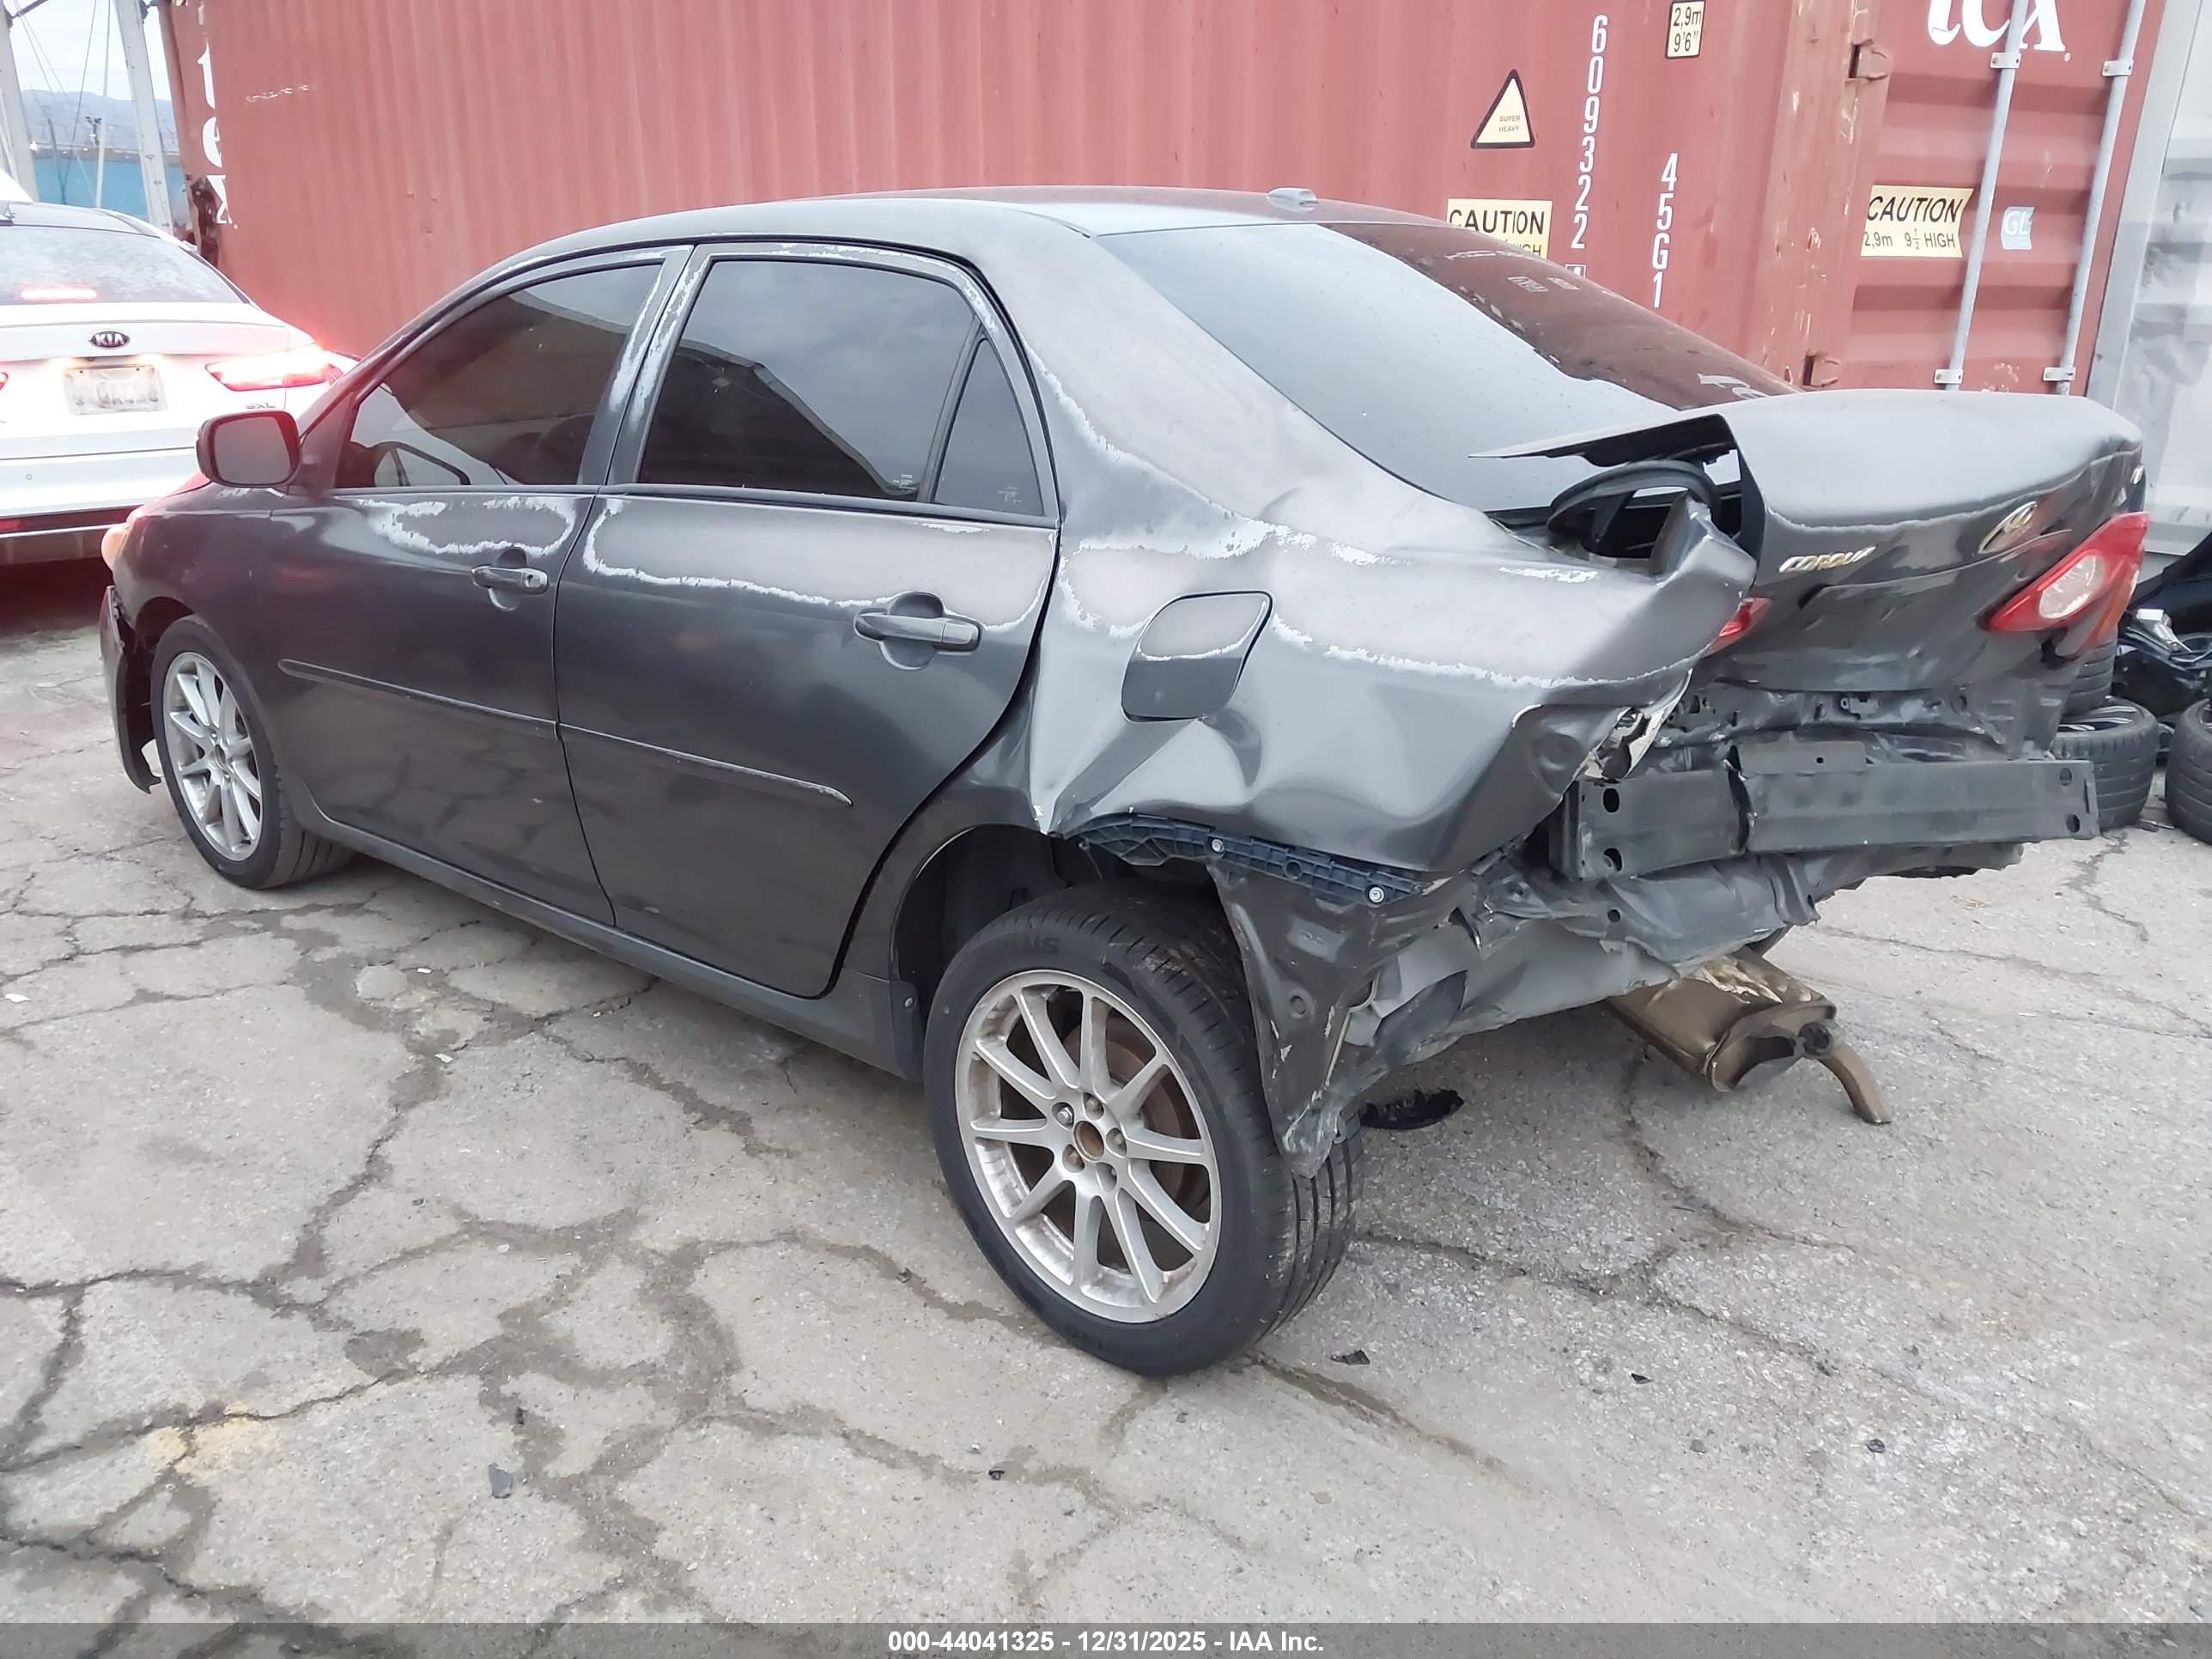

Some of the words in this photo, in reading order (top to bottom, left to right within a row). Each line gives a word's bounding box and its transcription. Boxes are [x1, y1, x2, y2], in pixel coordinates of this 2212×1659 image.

[1673, 6, 1701, 29] 2,9m
[1867, 196, 1964, 222] CAUTION
[1449, 209, 1545, 234] CAUTION
[1864, 232, 1893, 249] 2,9m
[1924, 233, 1956, 248] HIGH
[95, 333, 125, 346] KIA
